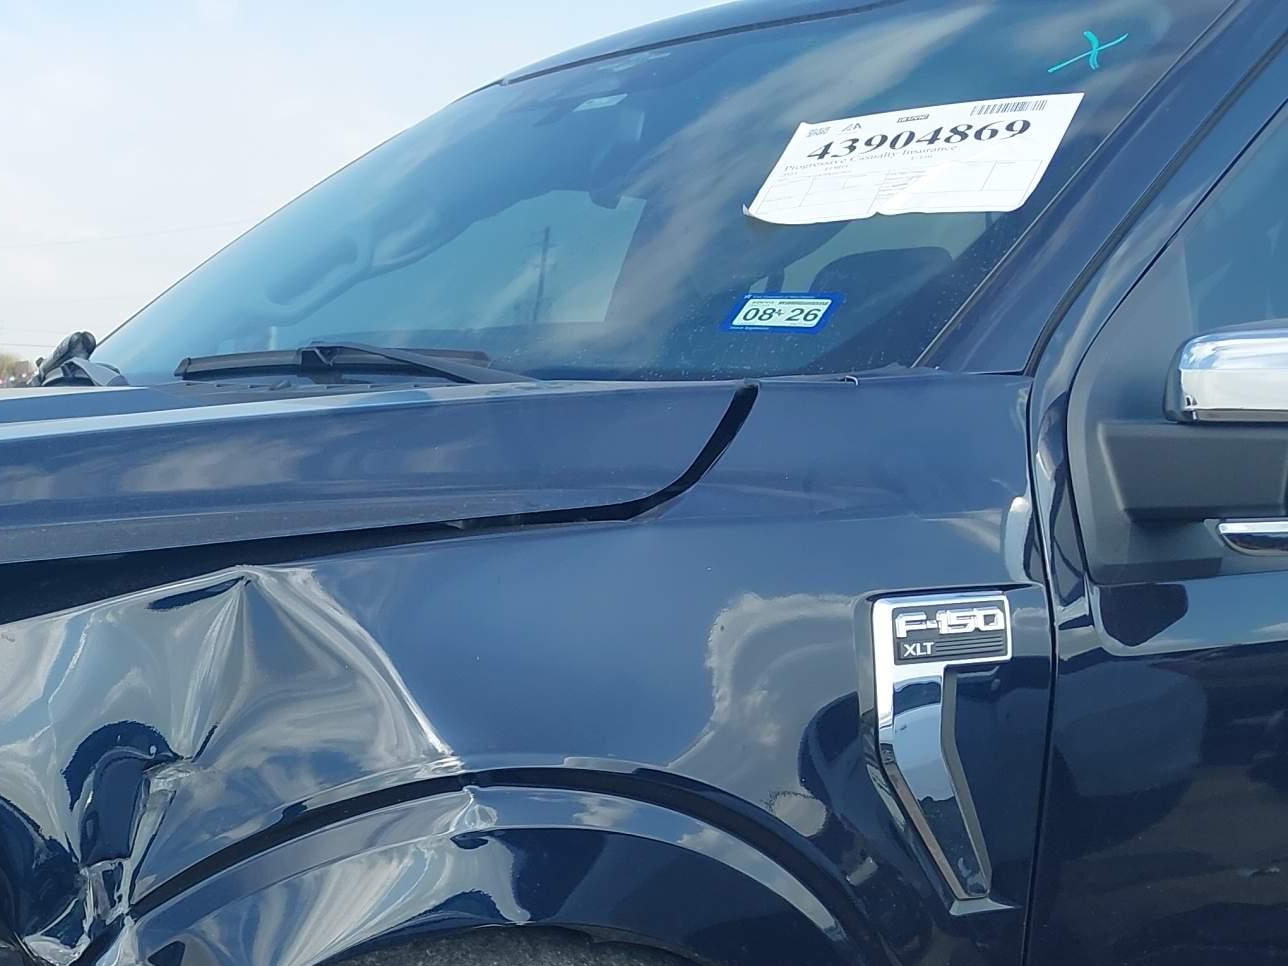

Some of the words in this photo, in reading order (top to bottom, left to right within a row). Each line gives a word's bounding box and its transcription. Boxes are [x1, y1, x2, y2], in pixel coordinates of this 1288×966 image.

[807, 119, 1031, 161] 43904869
[743, 307, 776, 321] 08
[785, 308, 822, 322] 26
[895, 606, 1006, 638] F-150
[904, 641, 934, 657] XLT
